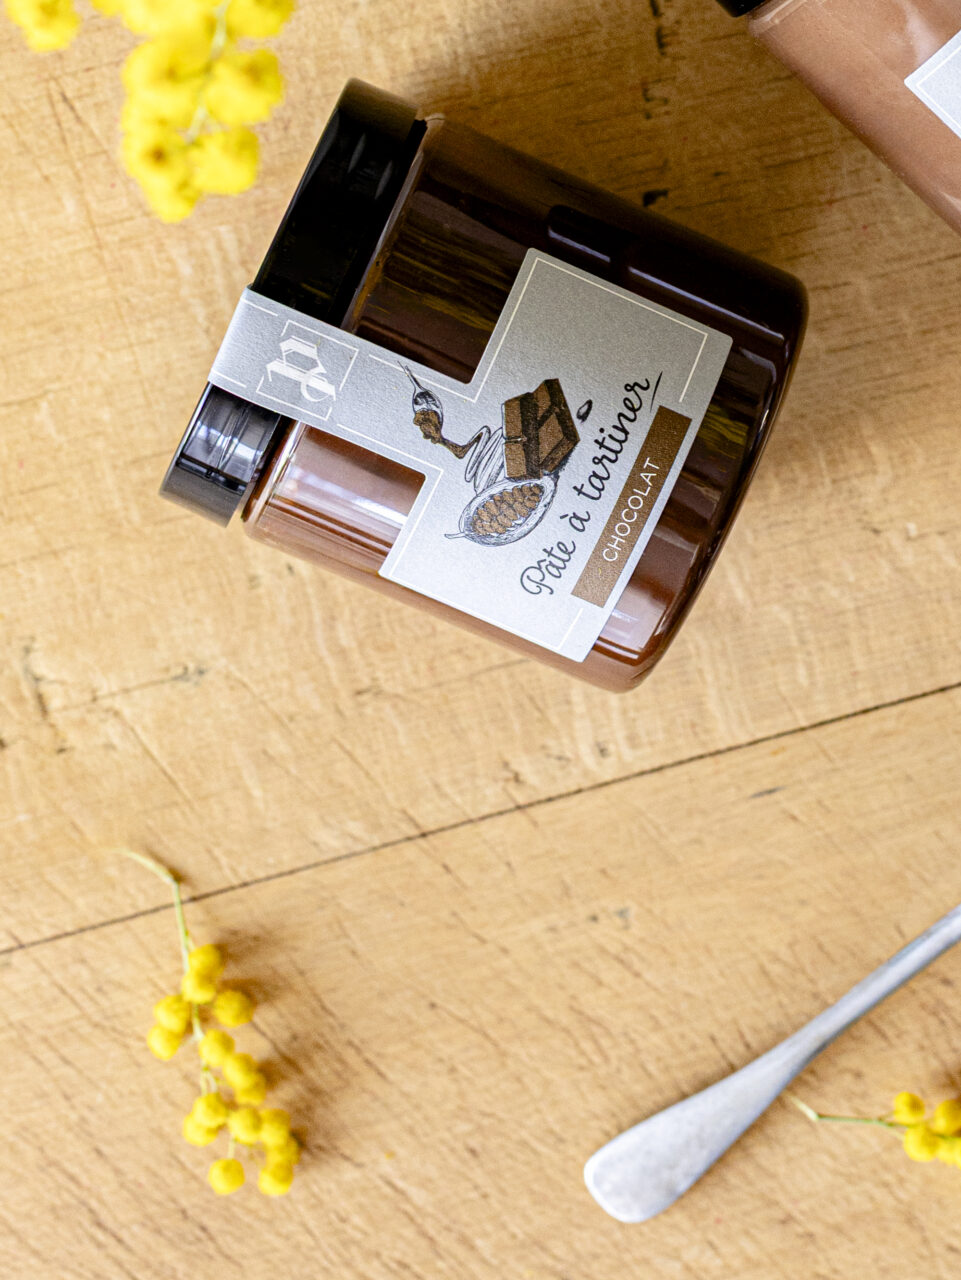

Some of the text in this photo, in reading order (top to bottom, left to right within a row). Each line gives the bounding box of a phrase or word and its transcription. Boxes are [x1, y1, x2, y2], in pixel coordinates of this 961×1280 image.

[519, 377, 651, 595] Pâte à tartiner
[602, 456, 660, 562] CHOCOLAT
